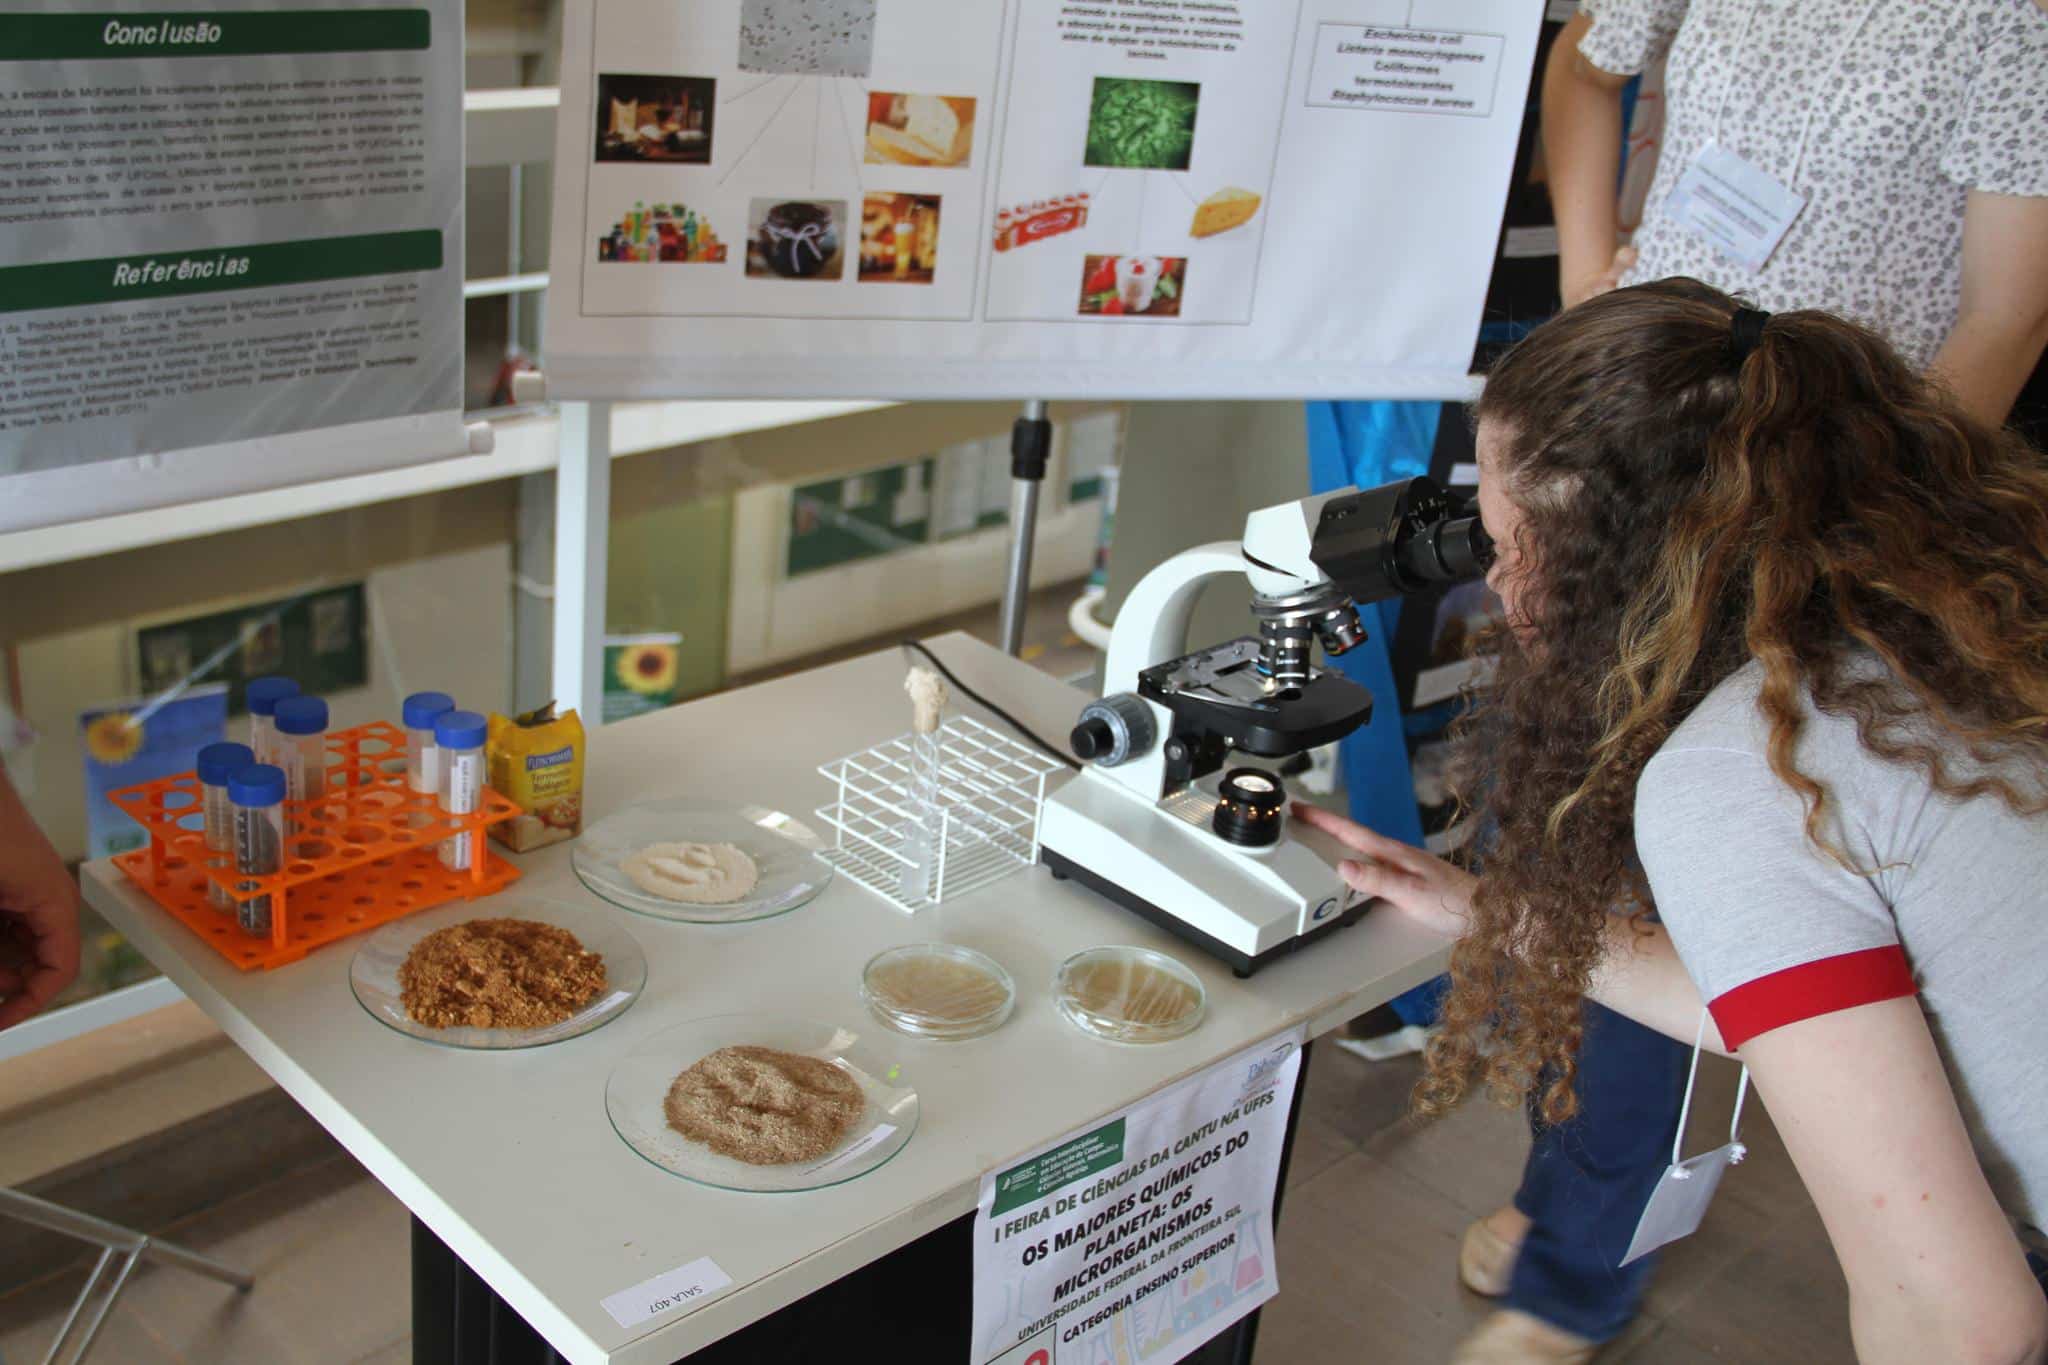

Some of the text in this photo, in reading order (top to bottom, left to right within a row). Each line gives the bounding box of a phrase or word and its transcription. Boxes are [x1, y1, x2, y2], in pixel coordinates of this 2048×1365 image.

[103, 20, 222, 45] Conclusão
[1363, 28, 1463, 45] Escherichia coli
[1336, 43, 1485, 62] Listeria monocytogenes
[1374, 61, 1440, 74] Coliformes
[1354, 76, 1453, 91] termotolerantes
[1432, 98, 1474, 108] aureus
[113, 255, 250, 286] Referências
[994, 1227, 1000, 1242] I
[1004, 1205, 1051, 1239] FEIRA
[1056, 1193, 1078, 1216] DE
[1081, 1158, 1148, 1204] CIÊNCIAS
[1149, 1146, 1170, 1169] DA
[1174, 1118, 1218, 1156] CANTU
[1221, 1106, 1240, 1129] NA
[1244, 1090, 1274, 1119] UFFS
[1021, 1130, 1249, 1267] OS MAIORES QUÍMICOS DO
[1083, 1185, 1193, 1261] PLANETA: OS
[1052, 1198, 1214, 1303] MICRORGANISMOS
[1018, 1205, 1242, 1340] UNIVERSIDADE FEDERAL DA FRONTEIRA SUL
[1063, 1232, 1237, 1343] CATEGORIA ENSINO SUPERIOR
[649, 1284, 704, 1314] SALA 407
